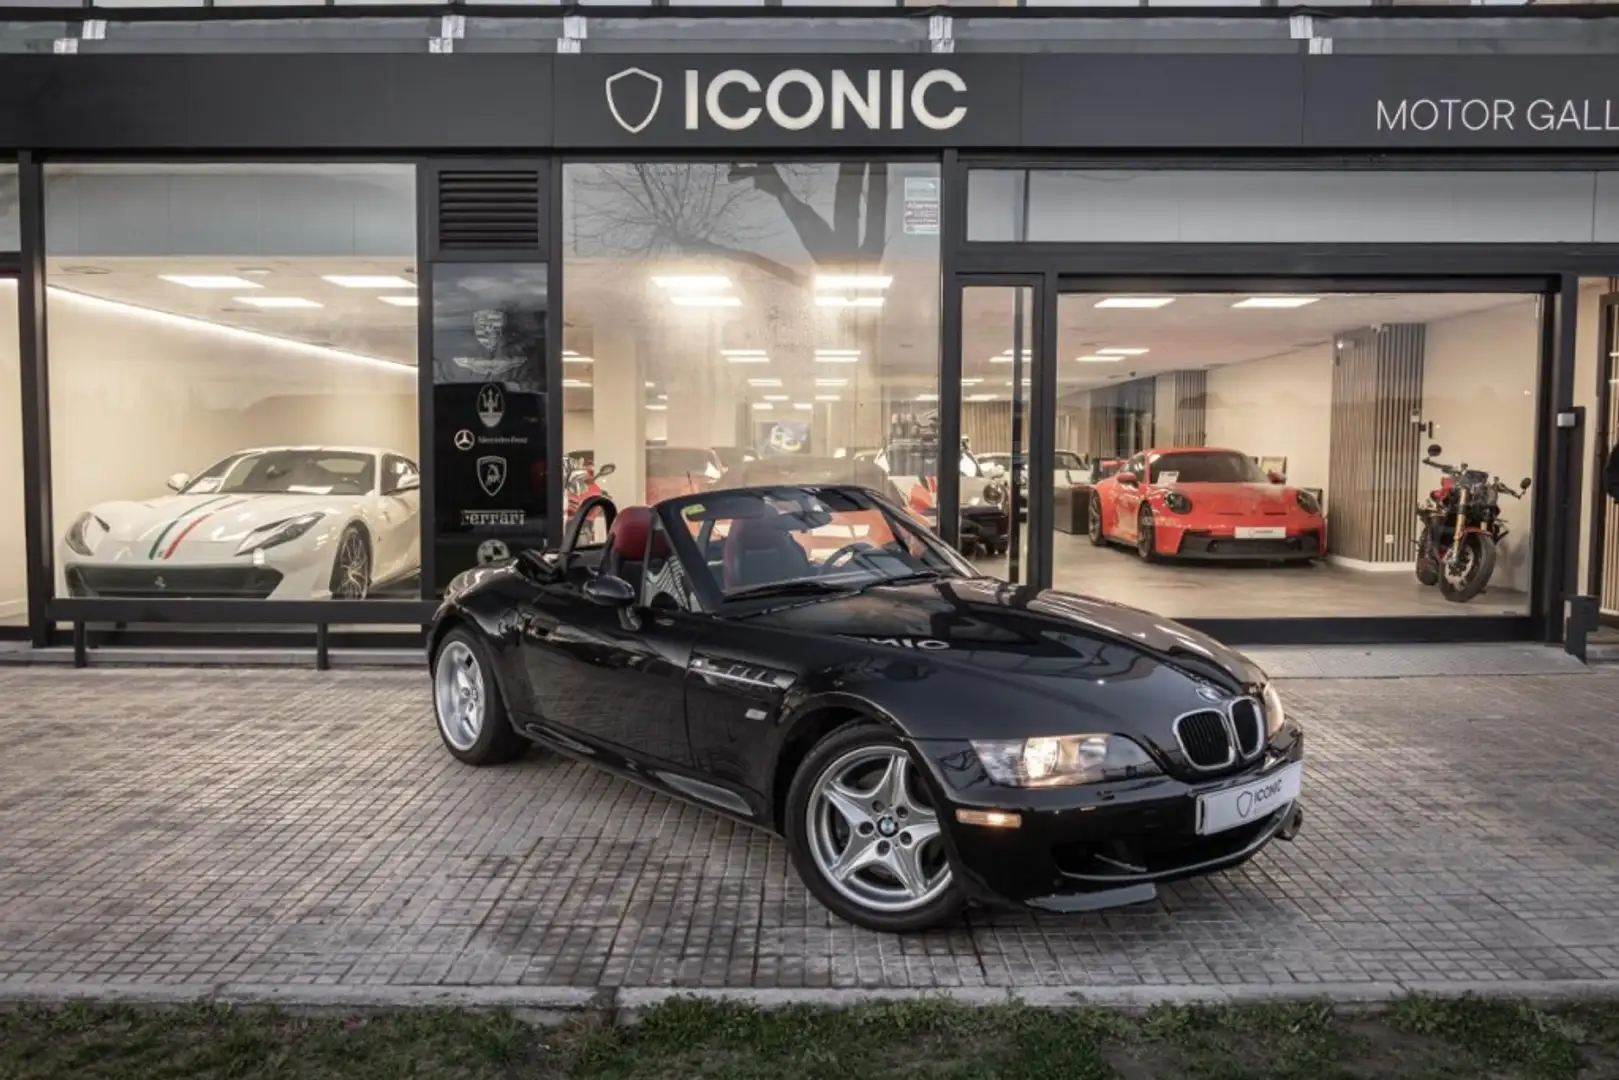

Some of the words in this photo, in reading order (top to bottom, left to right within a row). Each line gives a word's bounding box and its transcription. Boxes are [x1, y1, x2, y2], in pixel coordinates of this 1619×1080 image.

[685, 68, 968, 130] ICONIC
[1376, 98, 1516, 131] MOTOR
[1526, 98, 1619, 131] GALL
